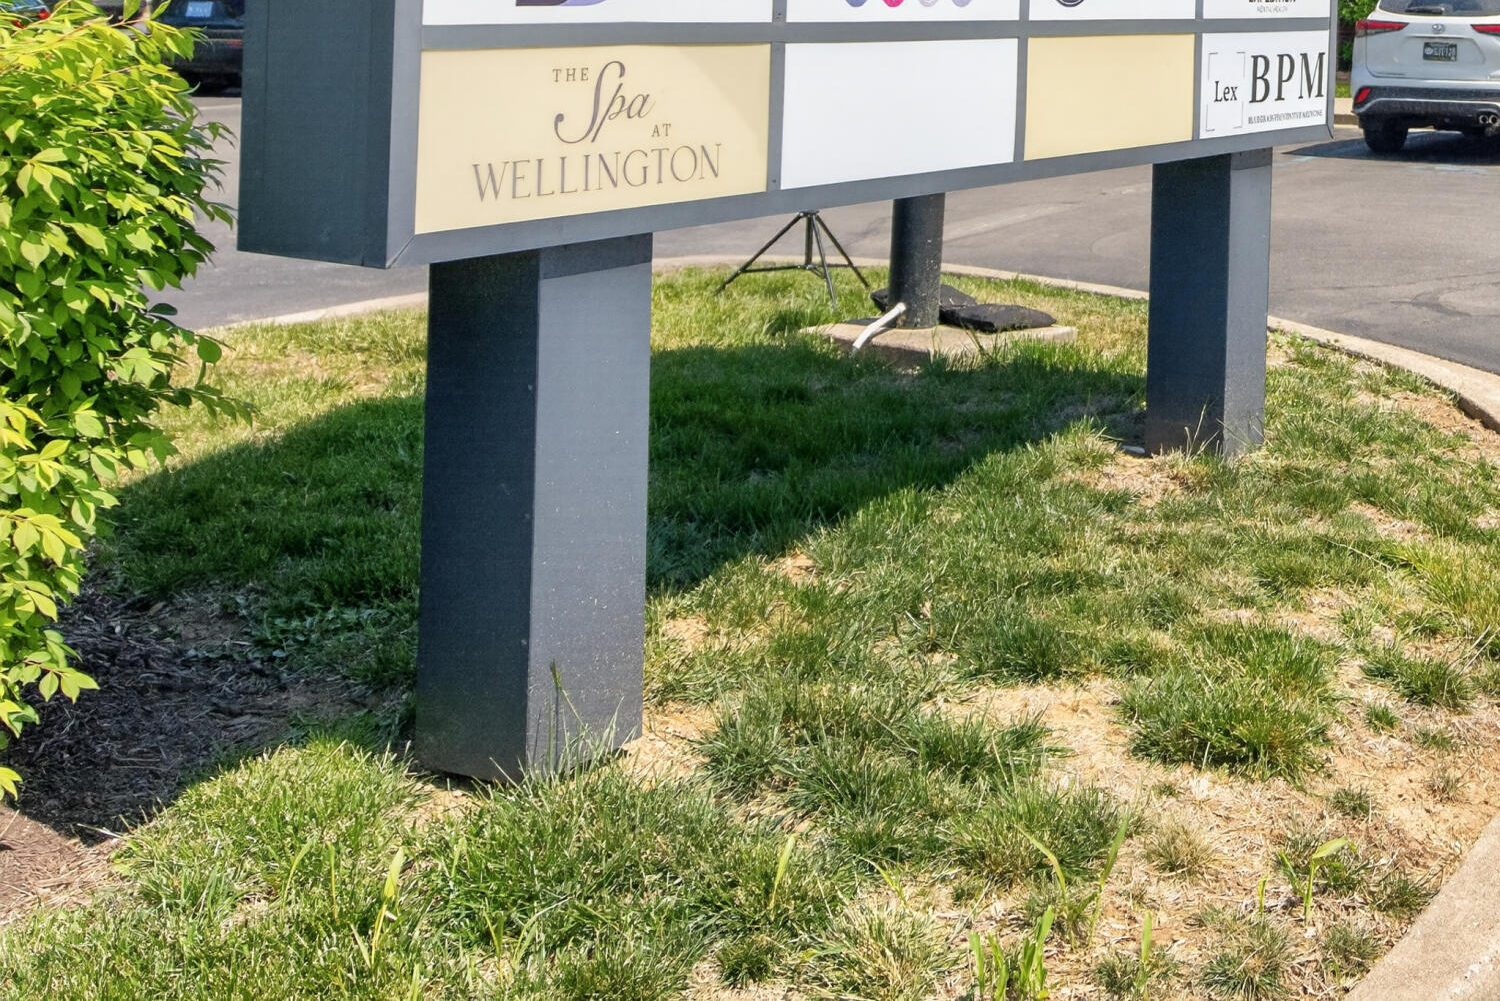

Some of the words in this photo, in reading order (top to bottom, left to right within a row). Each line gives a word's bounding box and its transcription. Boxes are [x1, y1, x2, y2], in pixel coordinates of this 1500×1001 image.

[552, 67, 589, 83] THE
[1213, 80, 1239, 102] Lex
[1248, 52, 1326, 103] BPM
[554, 60, 656, 145] Spa
[651, 123, 671, 137] AT
[472, 143, 722, 203] WELLINGTON
